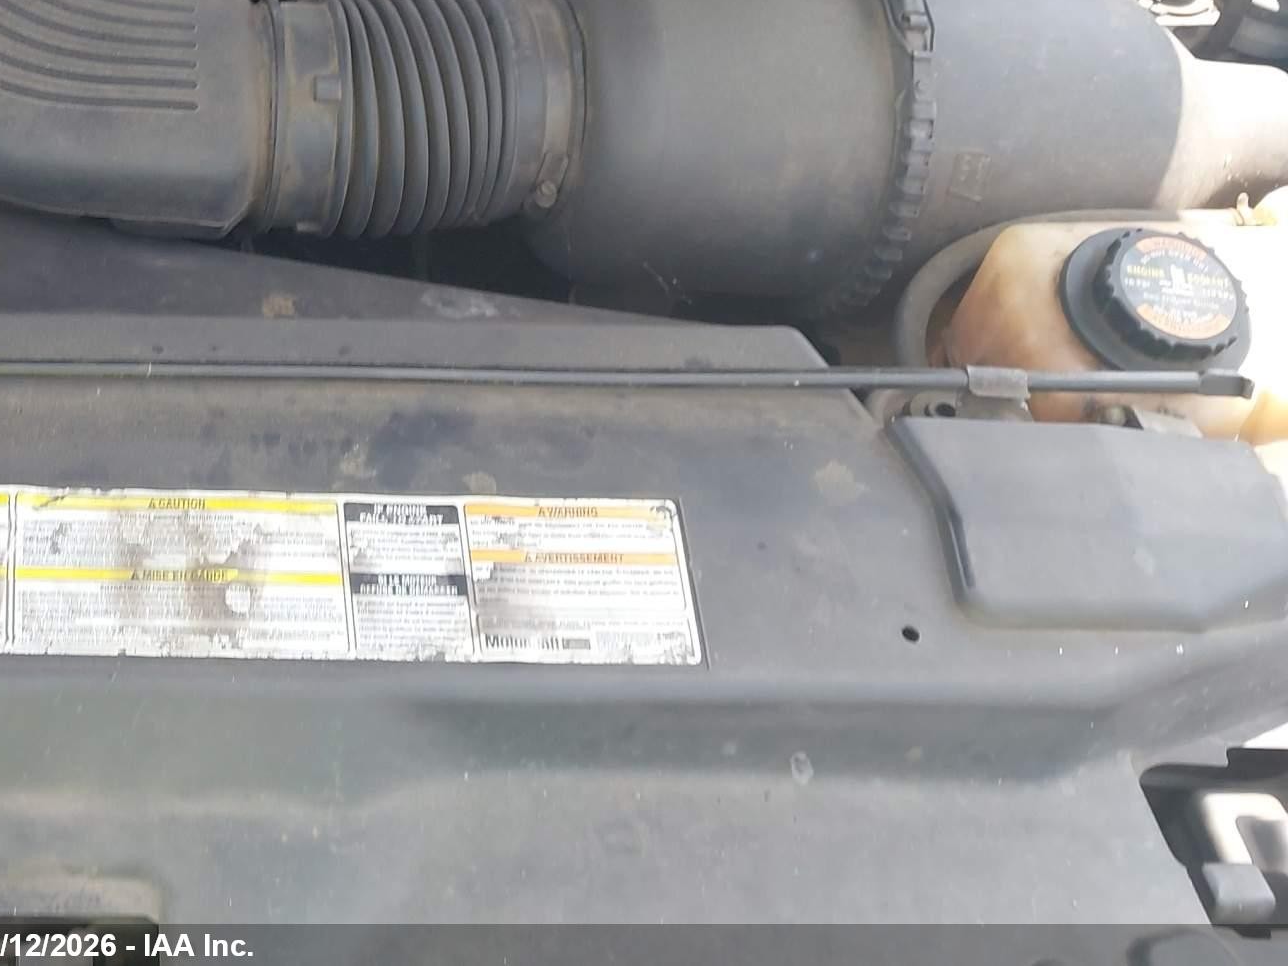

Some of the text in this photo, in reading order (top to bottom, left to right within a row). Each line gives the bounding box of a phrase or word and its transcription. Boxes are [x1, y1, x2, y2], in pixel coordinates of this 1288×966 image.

[158, 498, 206, 511] CAUTION
[546, 507, 599, 519] WARNING
[534, 553, 625, 565] AVERTISSEMENT
